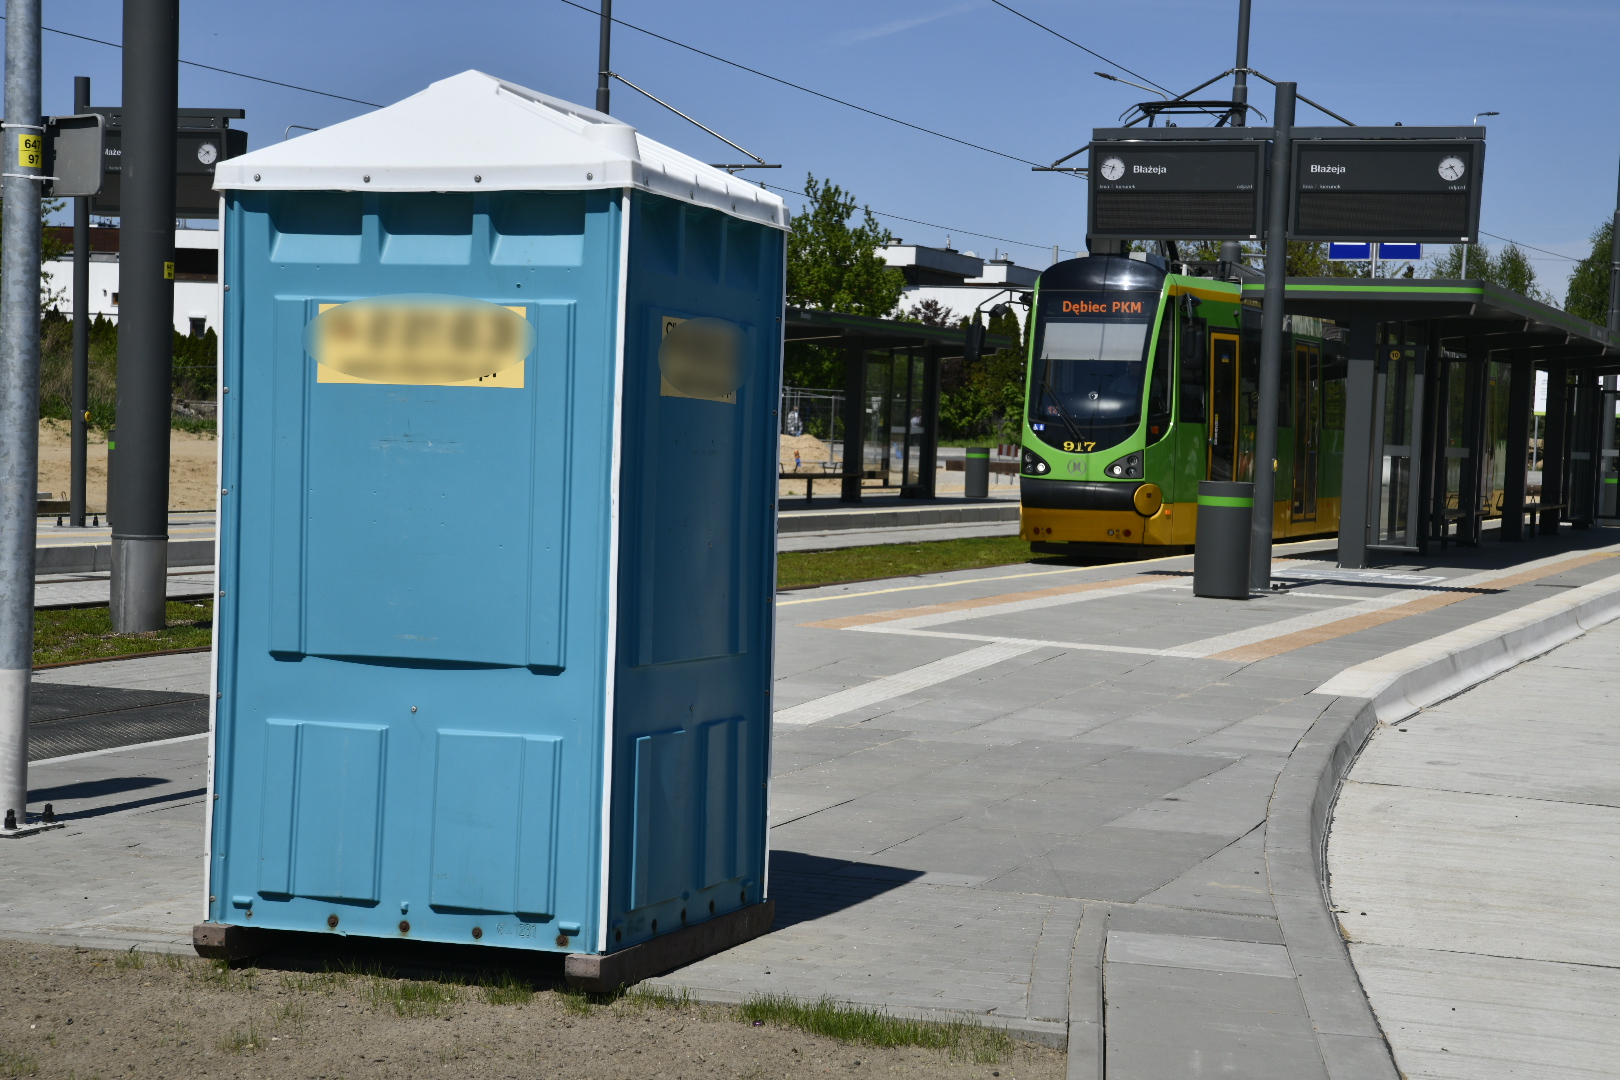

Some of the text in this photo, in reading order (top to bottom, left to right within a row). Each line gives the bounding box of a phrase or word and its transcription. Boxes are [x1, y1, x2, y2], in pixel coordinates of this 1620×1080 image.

[24, 138, 41, 150] 647
[28, 154, 40, 165] 97
[1133, 165, 1167, 175] Błażeja
[1310, 164, 1346, 175] Błażeja
[1062, 300, 1142, 315] Dębiec PKM
[1063, 440, 1096, 452] 917
